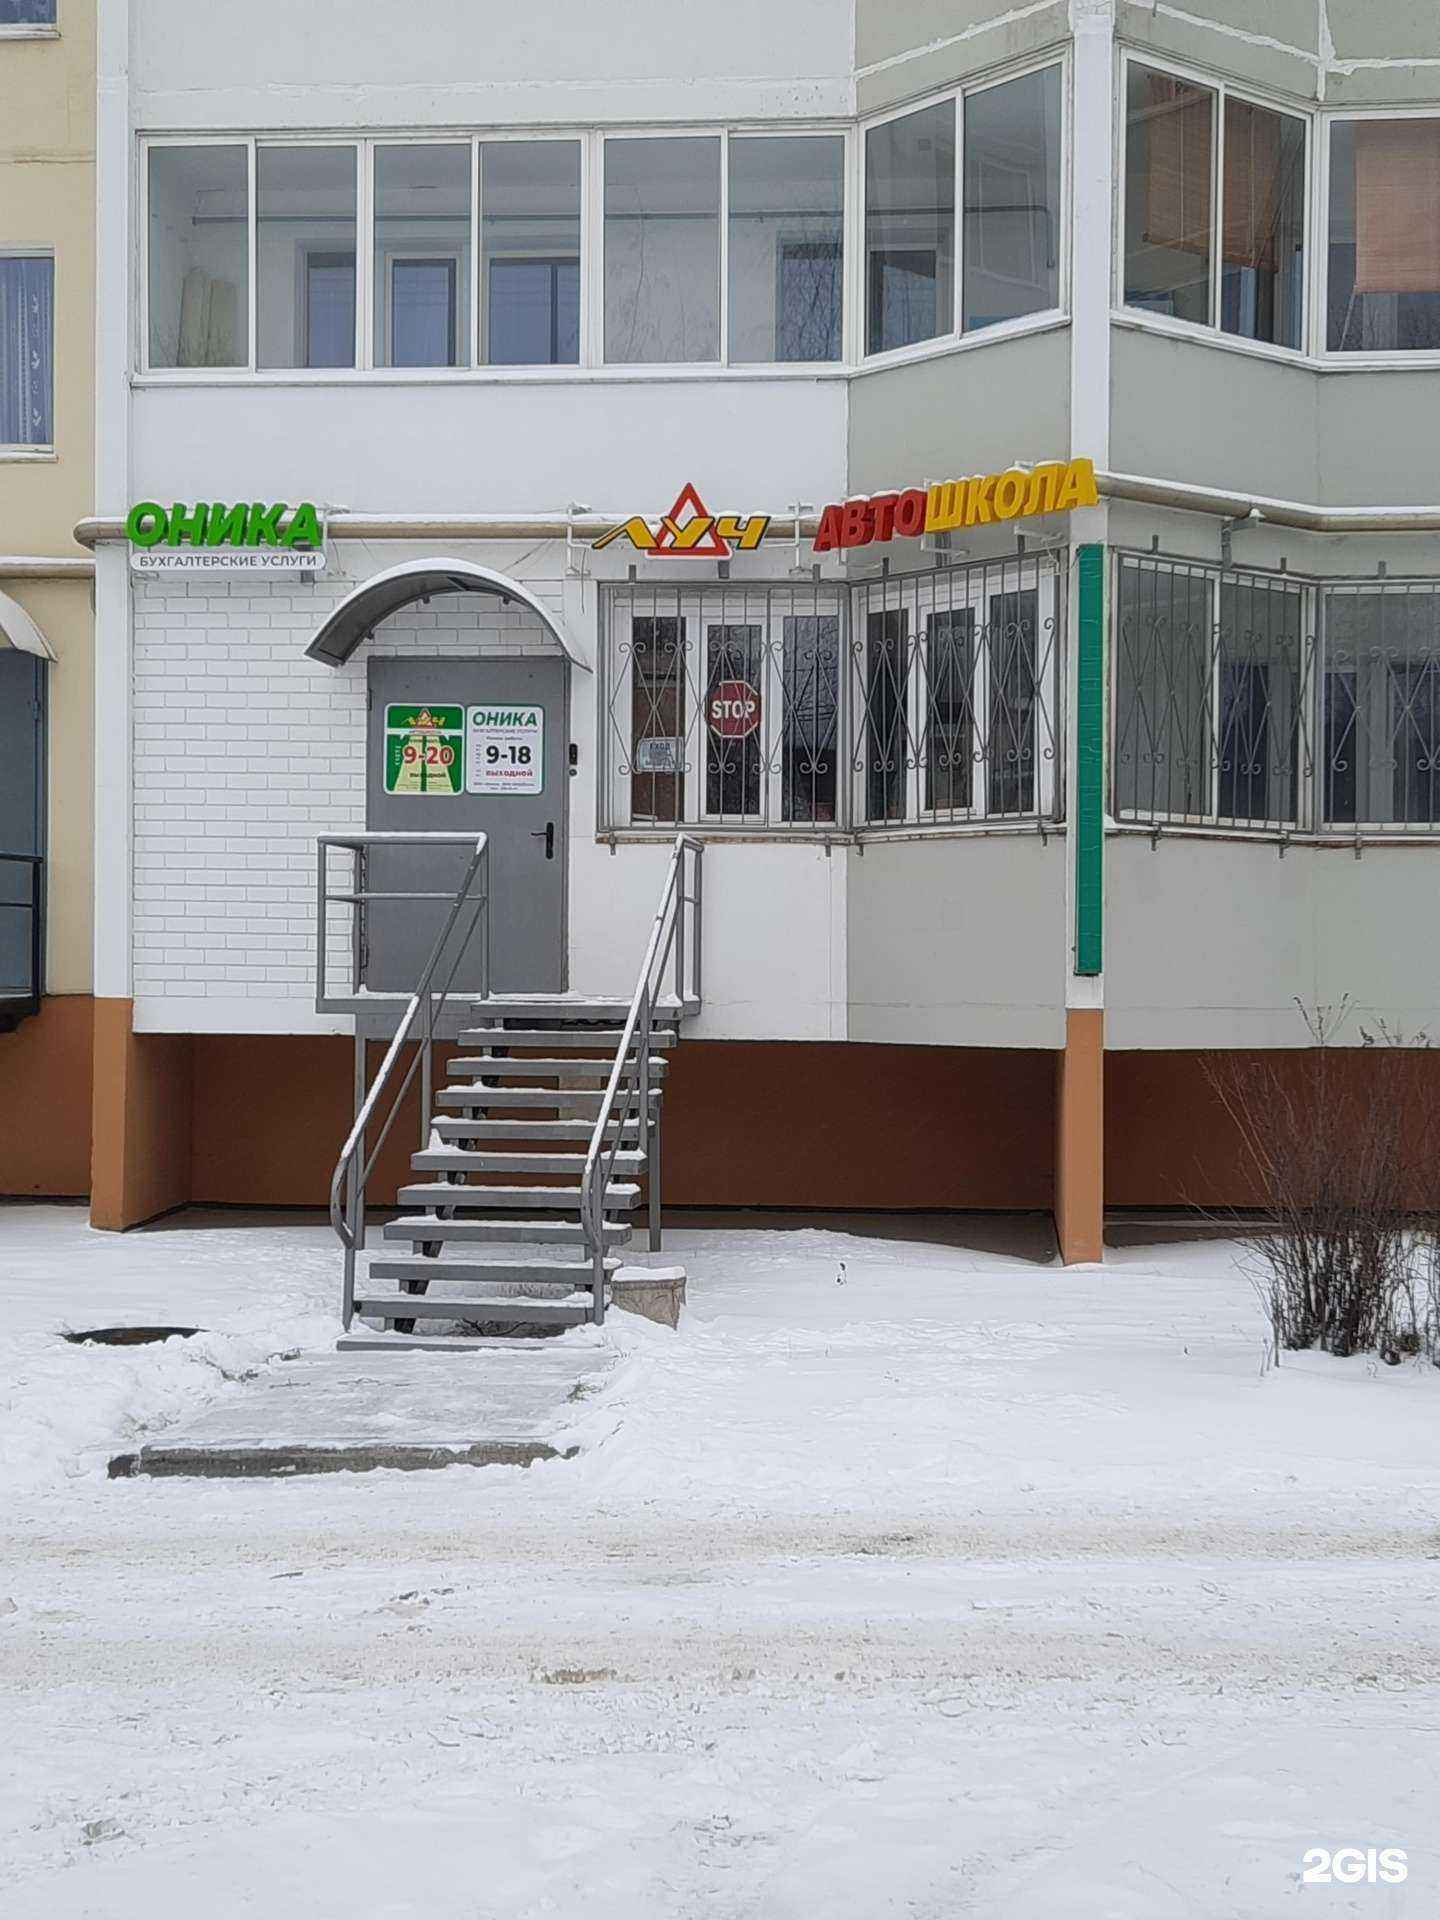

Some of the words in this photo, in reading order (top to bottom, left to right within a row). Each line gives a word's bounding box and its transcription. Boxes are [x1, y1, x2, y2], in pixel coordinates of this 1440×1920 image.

[813, 457, 1099, 551] АВТОШКОЛА
[127, 501, 323, 548] ОНИКА
[591, 515, 772, 550] ЛУЧ
[139, 555, 257, 568] БУХГАЛТЕРСКИЕ
[260, 555, 317, 568] УСЛУГИ
[472, 711, 538, 727] ОНИКА
[712, 700, 756, 719] STOP
[403, 745, 454, 766] 9-20
[486, 745, 532, 765] 9-18
